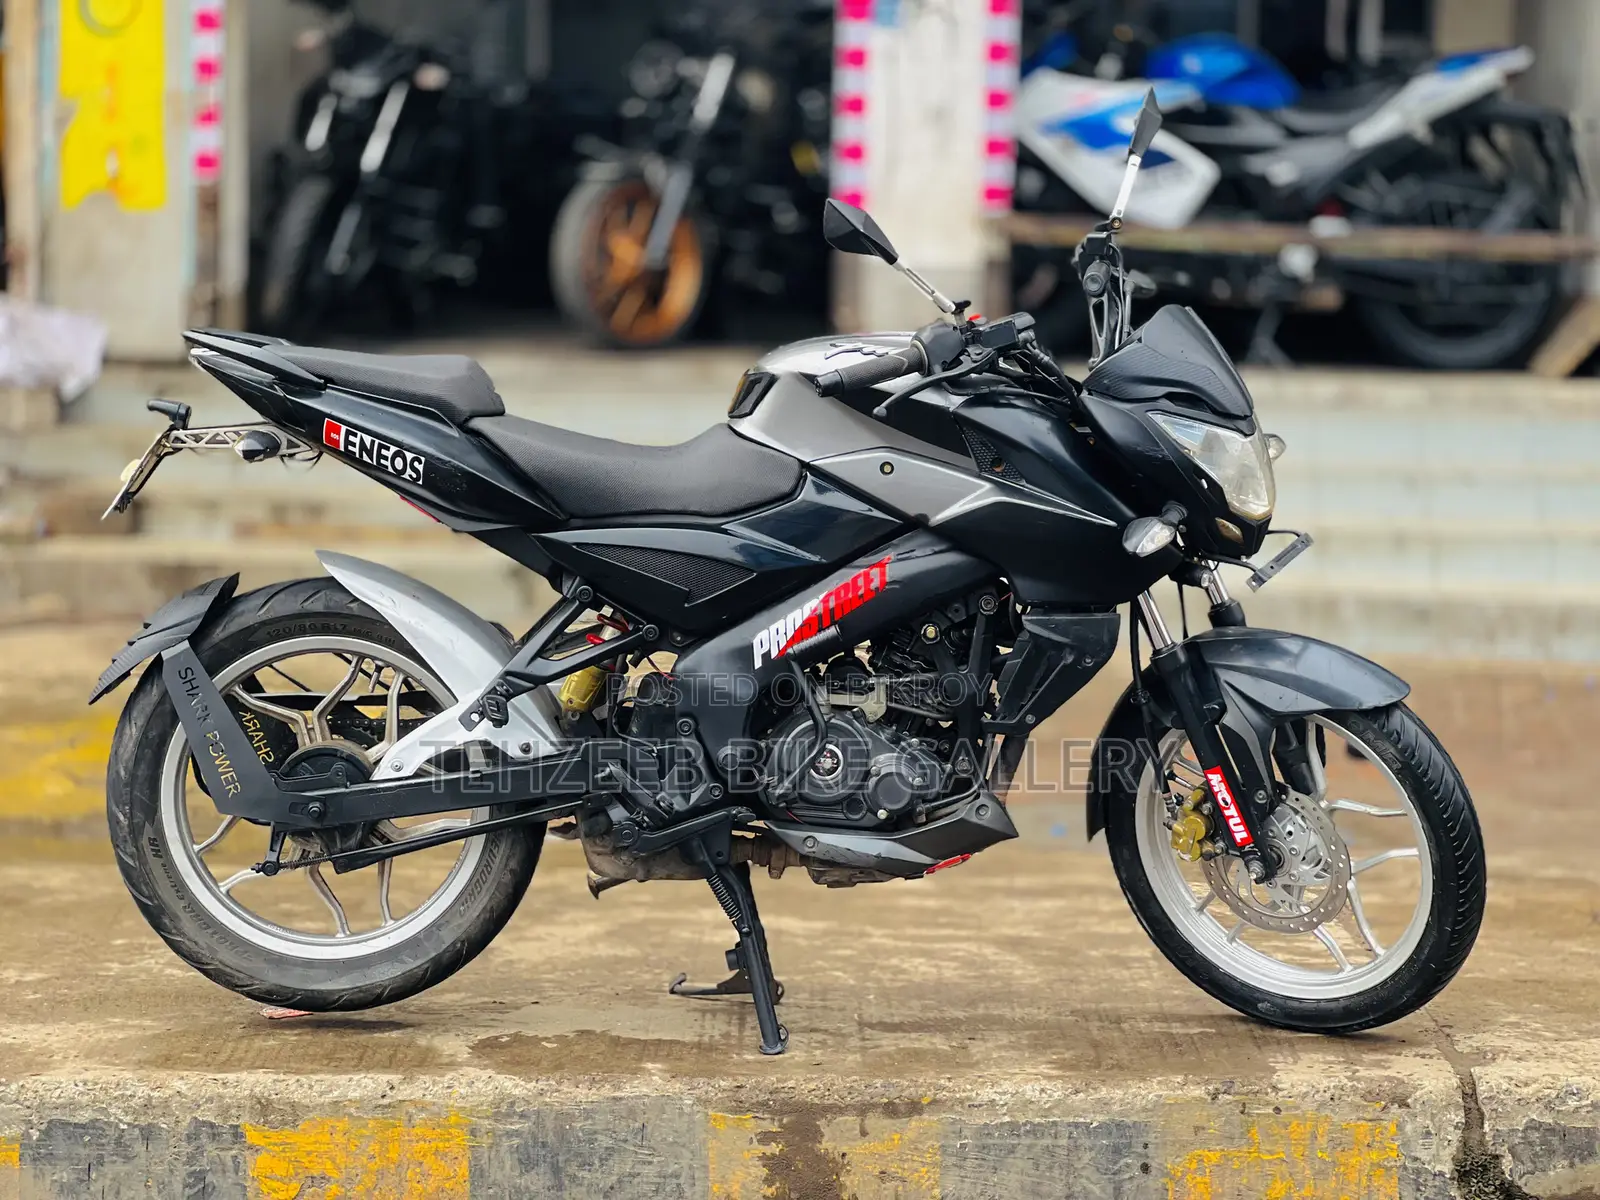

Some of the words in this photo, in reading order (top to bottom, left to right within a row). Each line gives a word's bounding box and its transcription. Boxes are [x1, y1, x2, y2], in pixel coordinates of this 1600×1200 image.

[343, 427, 424, 483] ENEOS
[203, 730, 241, 799] POWER
[1206, 773, 1249, 843] MOTUL
